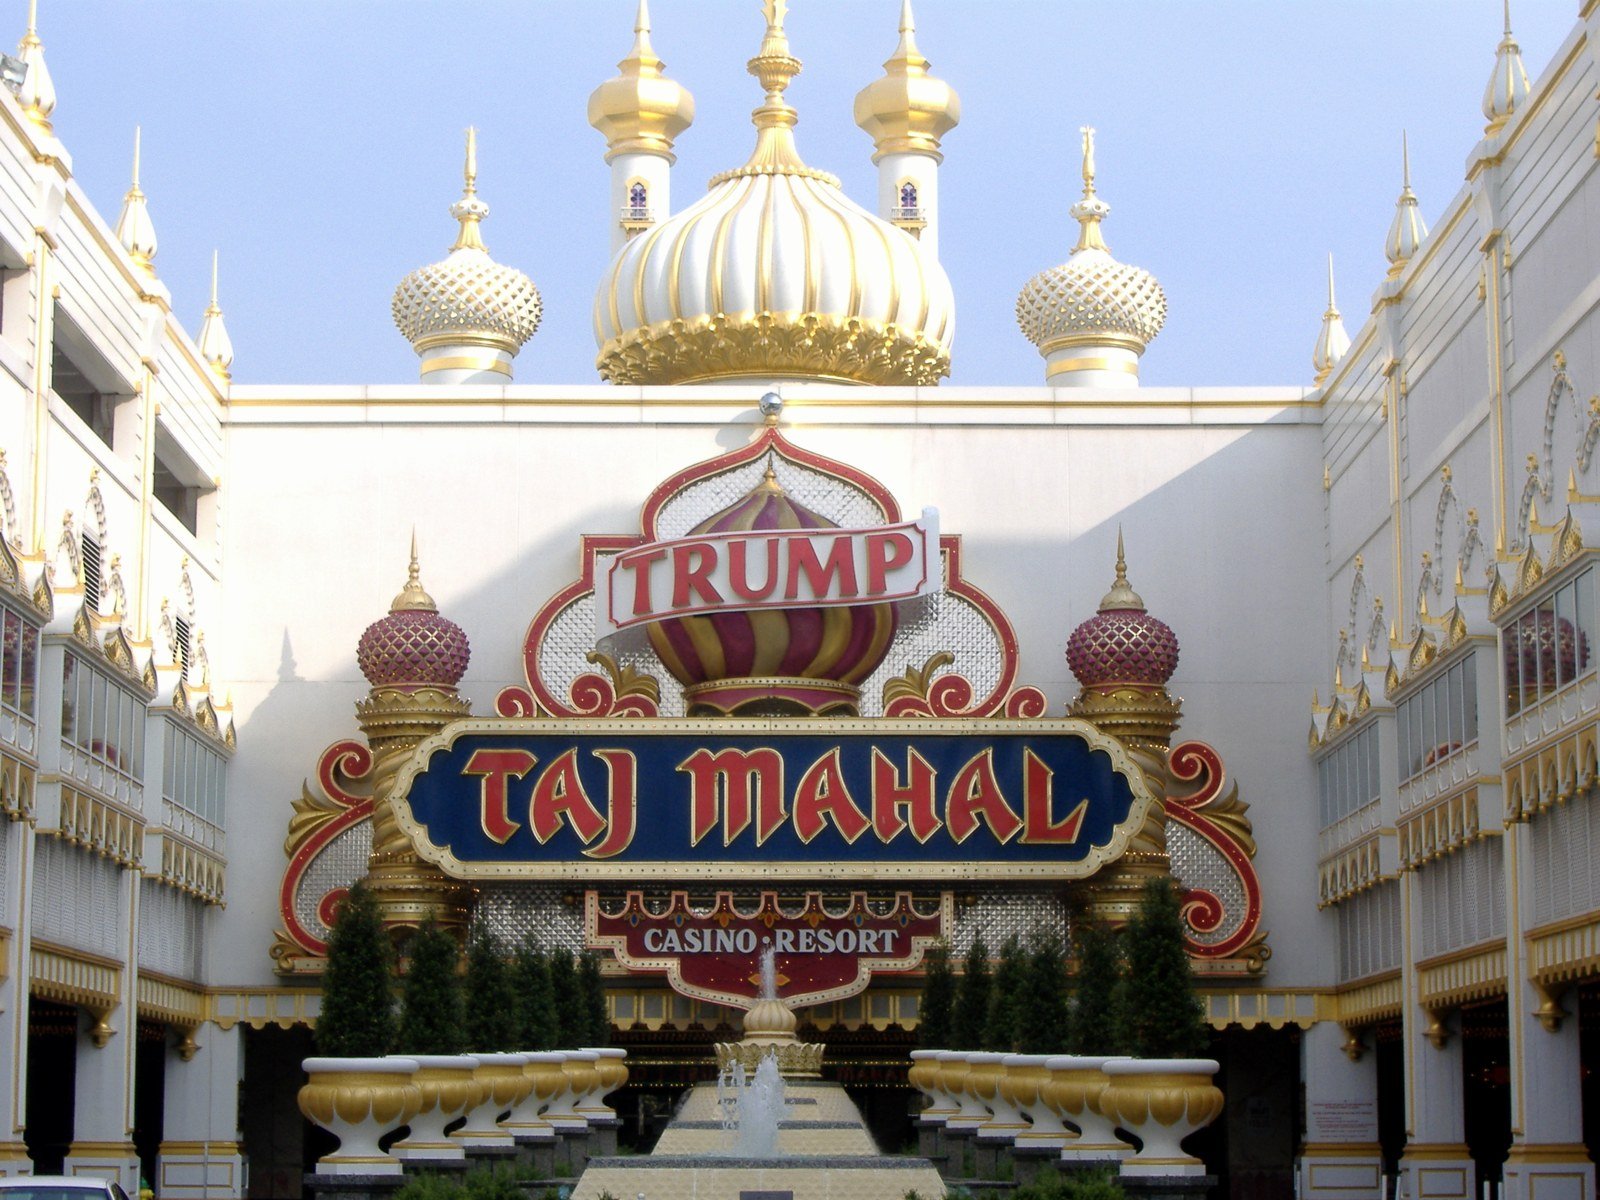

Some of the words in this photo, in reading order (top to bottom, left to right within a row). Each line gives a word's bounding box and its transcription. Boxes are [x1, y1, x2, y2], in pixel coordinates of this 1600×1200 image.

[621, 532, 914, 616] TRUMP
[461, 747, 637, 858] TAJ
[675, 746, 1089, 848] MAHAL
[643, 928, 757, 953] CASINO
[774, 928, 899, 953] RESORT
